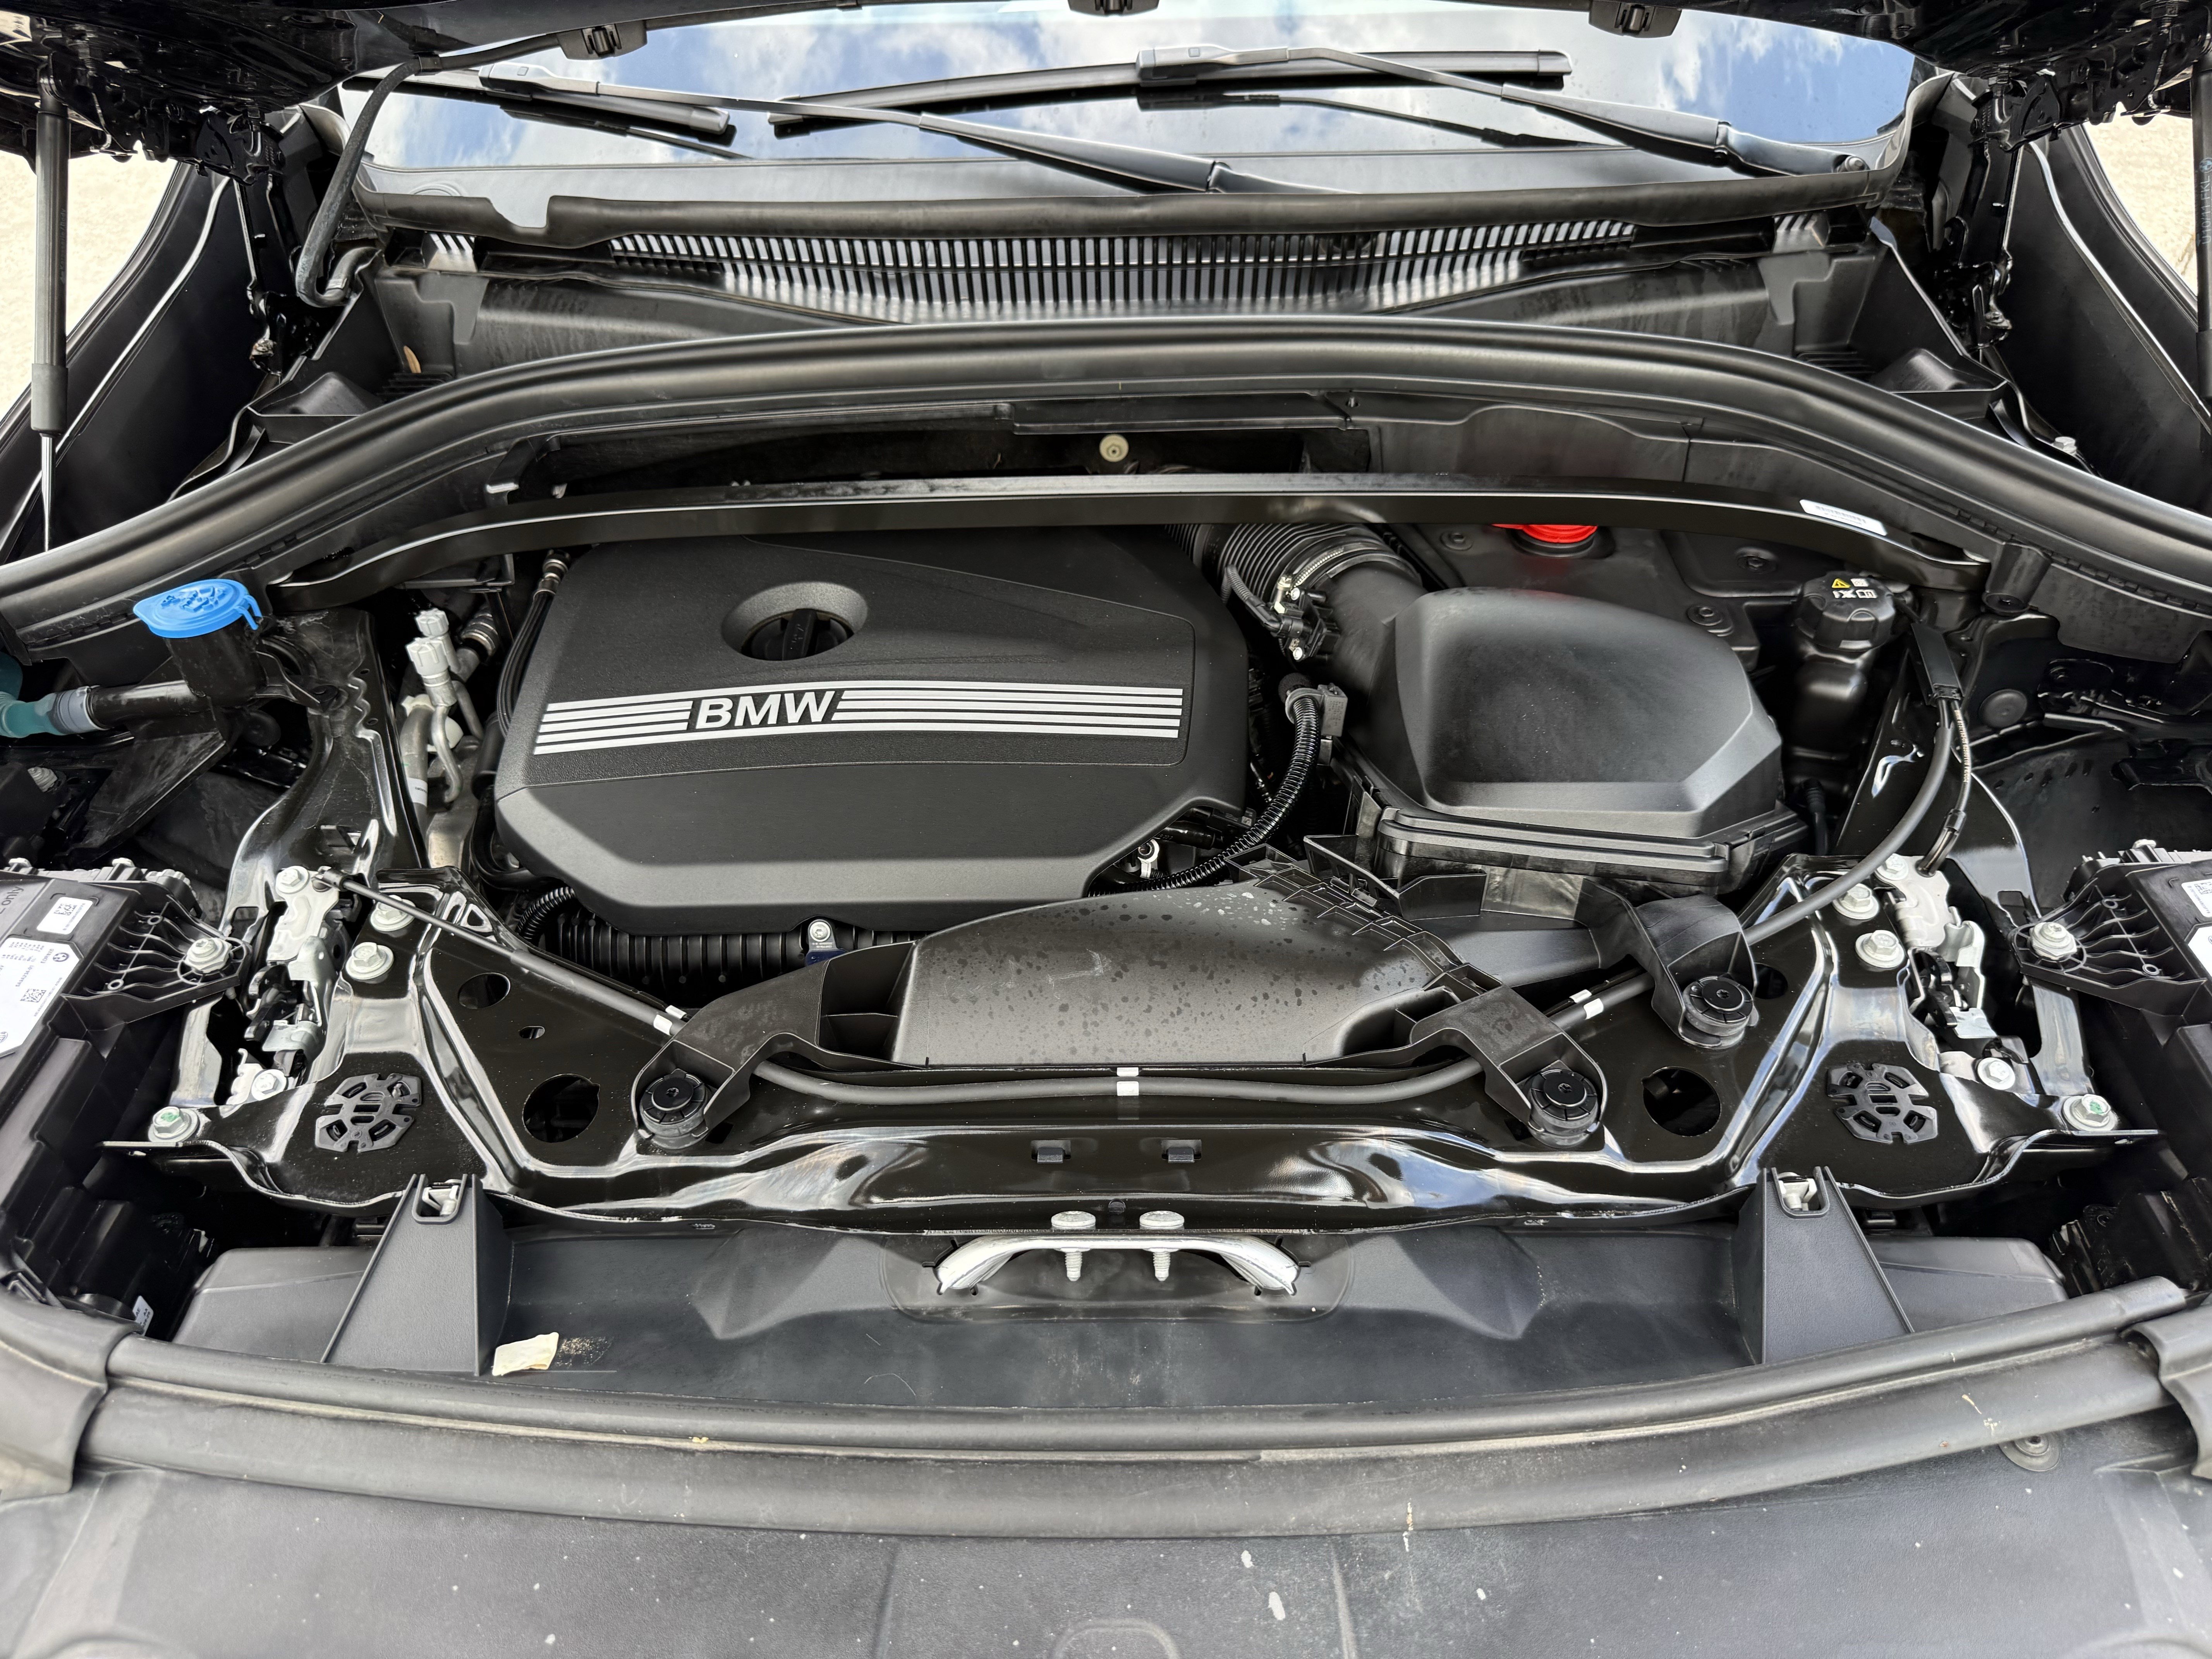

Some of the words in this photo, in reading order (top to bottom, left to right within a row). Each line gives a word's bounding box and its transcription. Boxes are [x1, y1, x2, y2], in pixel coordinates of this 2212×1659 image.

[2200, 175, 2210, 200] FKL
[2201, 205, 2211, 244] U10/11
[696, 690, 835, 729] BMW
[2, 886, 24, 905] only
